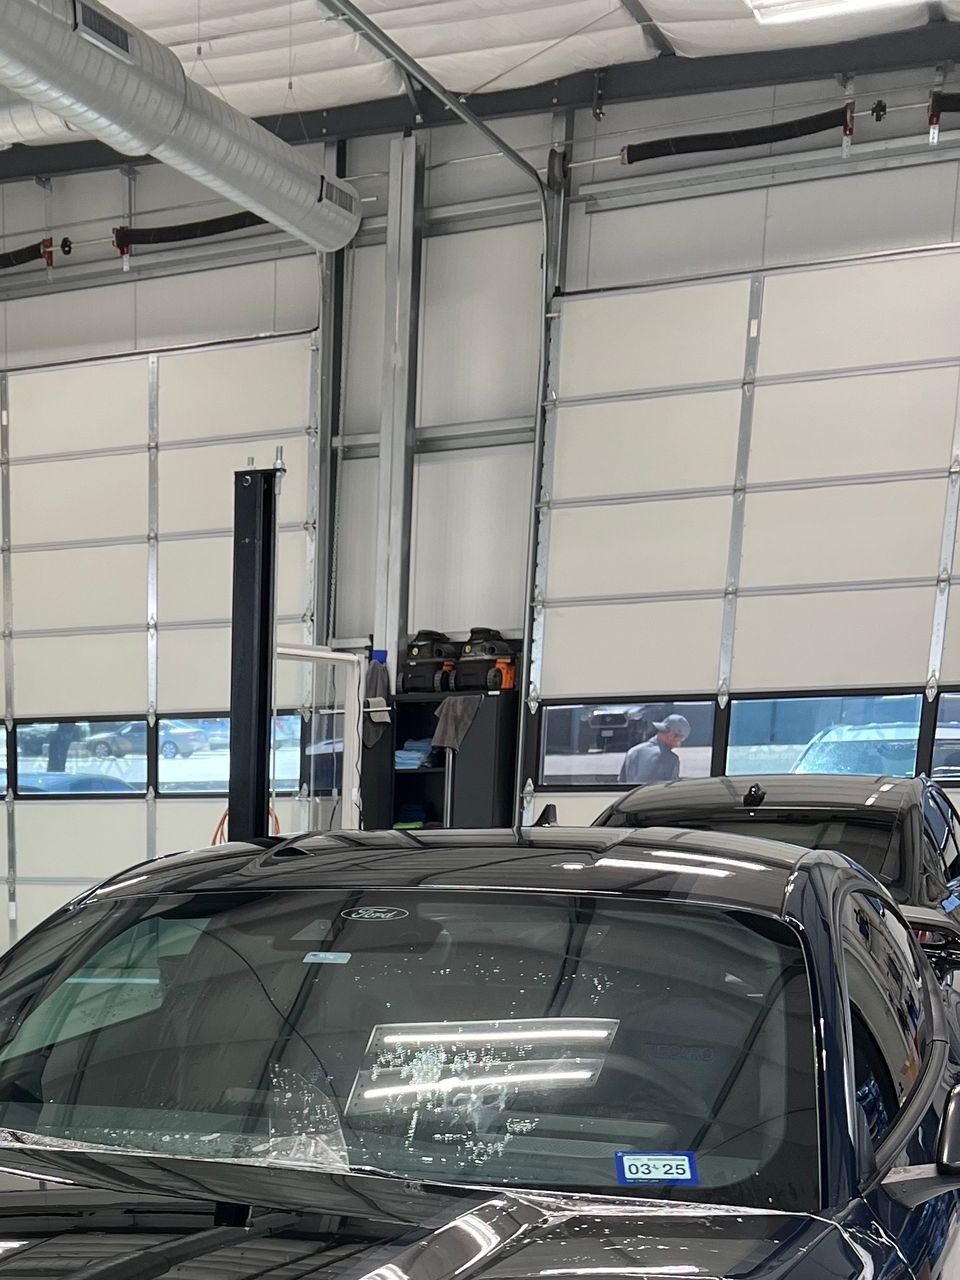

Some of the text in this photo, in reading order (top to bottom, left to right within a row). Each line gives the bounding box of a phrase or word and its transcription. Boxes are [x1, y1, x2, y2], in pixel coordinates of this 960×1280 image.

[351, 907, 398, 919] Ford
[628, 1163, 686, 1176] 03 25
